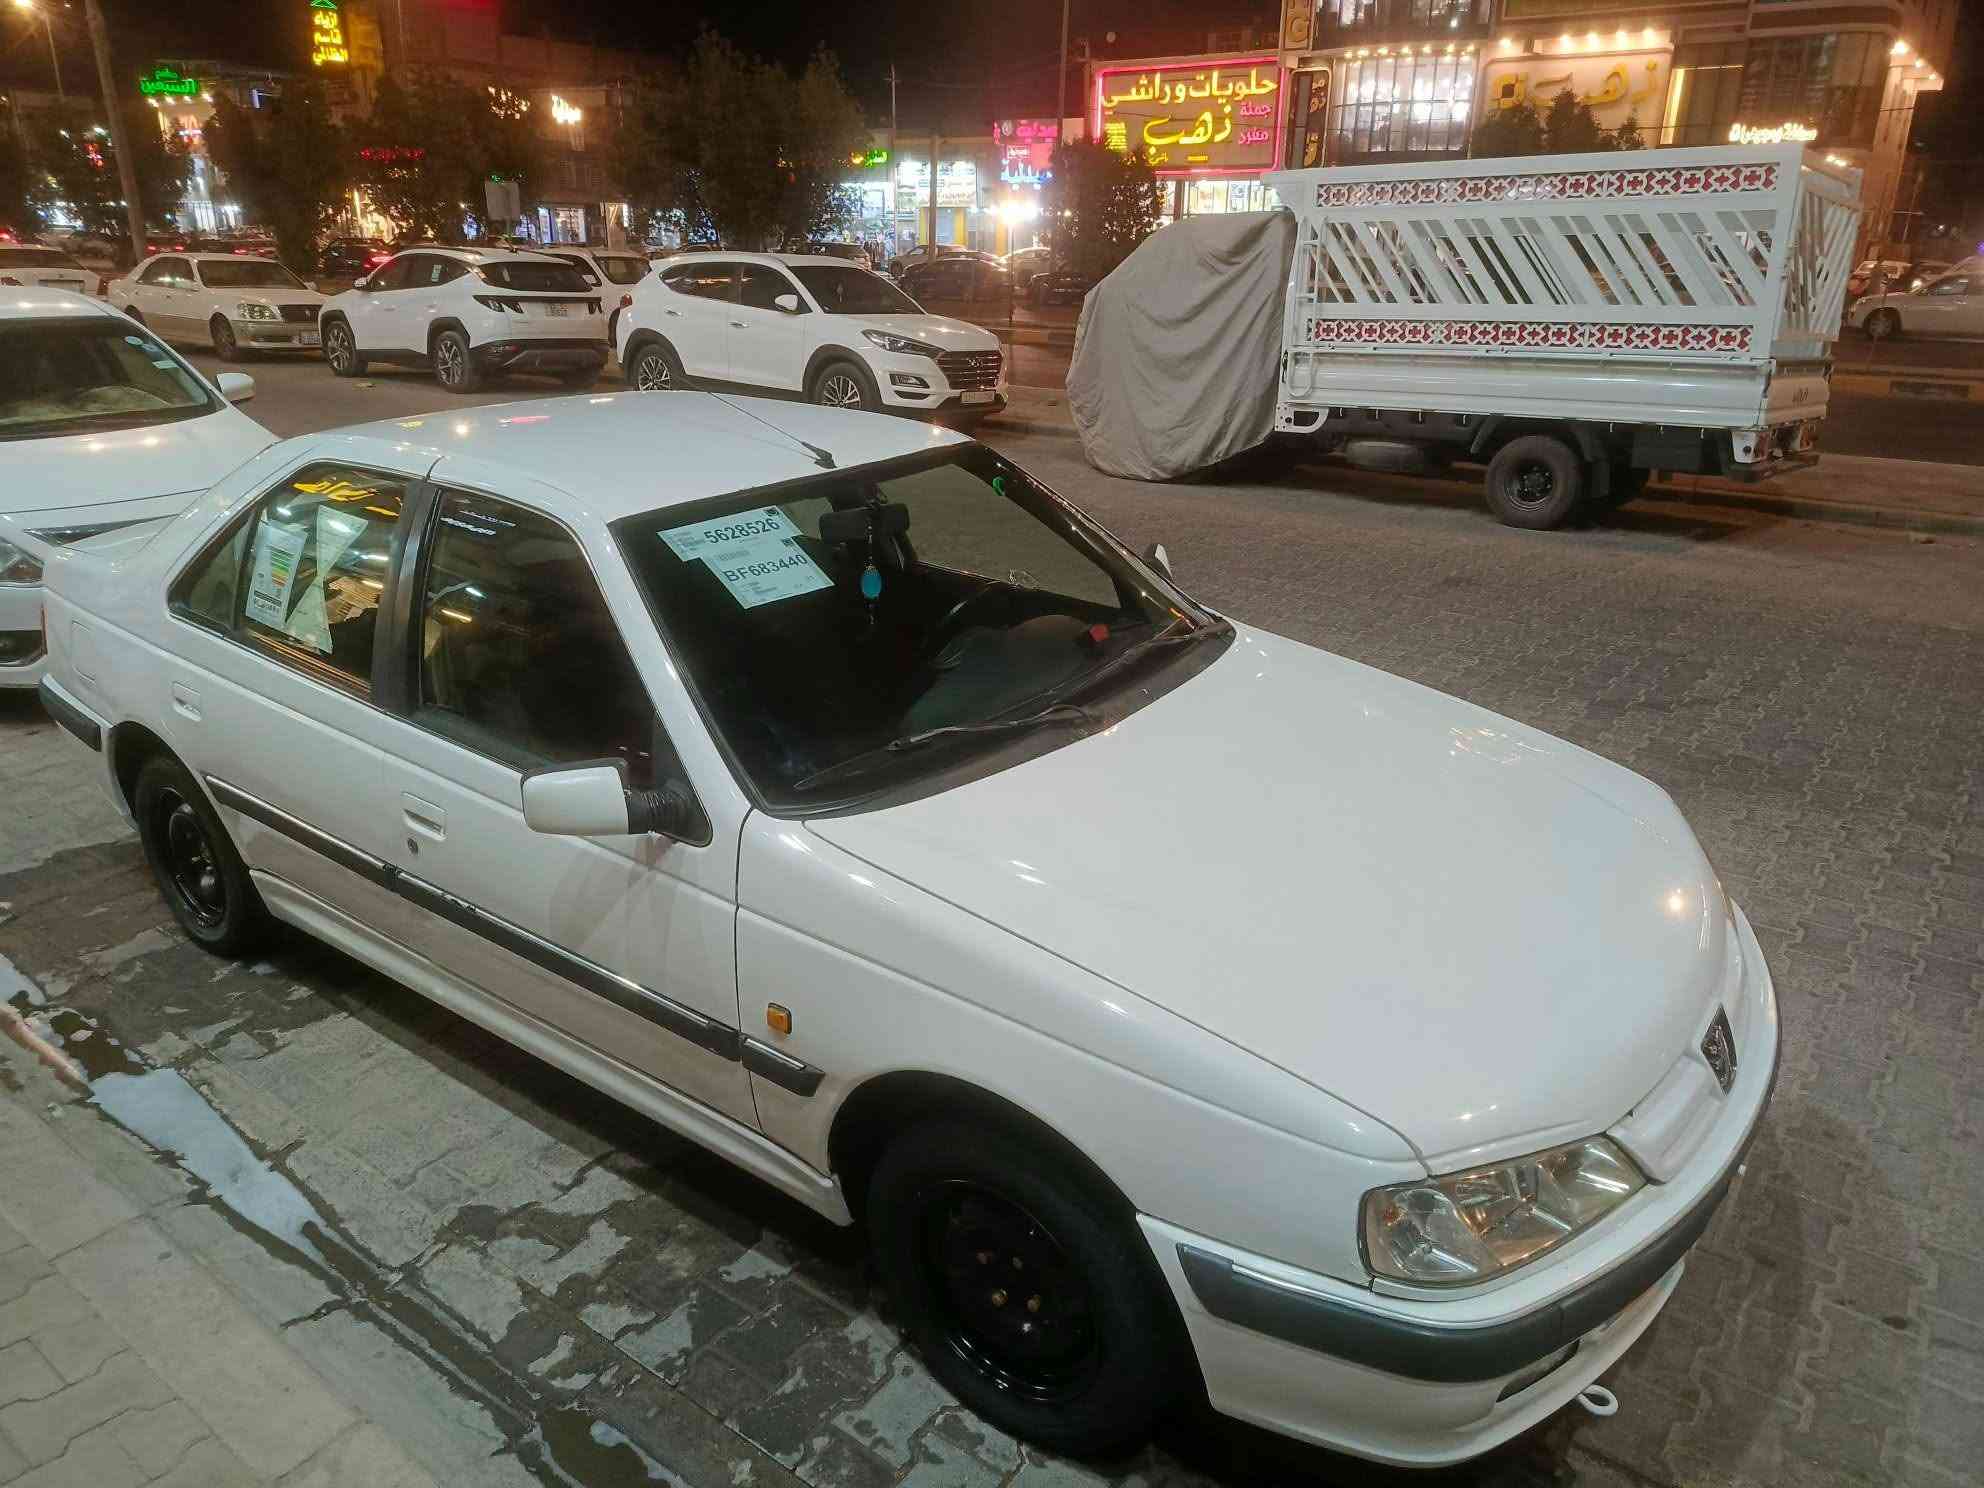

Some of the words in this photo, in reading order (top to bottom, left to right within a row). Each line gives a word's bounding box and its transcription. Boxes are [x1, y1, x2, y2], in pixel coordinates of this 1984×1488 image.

[1189, 67, 1278, 105] حلويات
[1239, 101, 1272, 118] جملة
[703, 517, 781, 545] 5628526
[722, 553, 808, 583] BF683440
